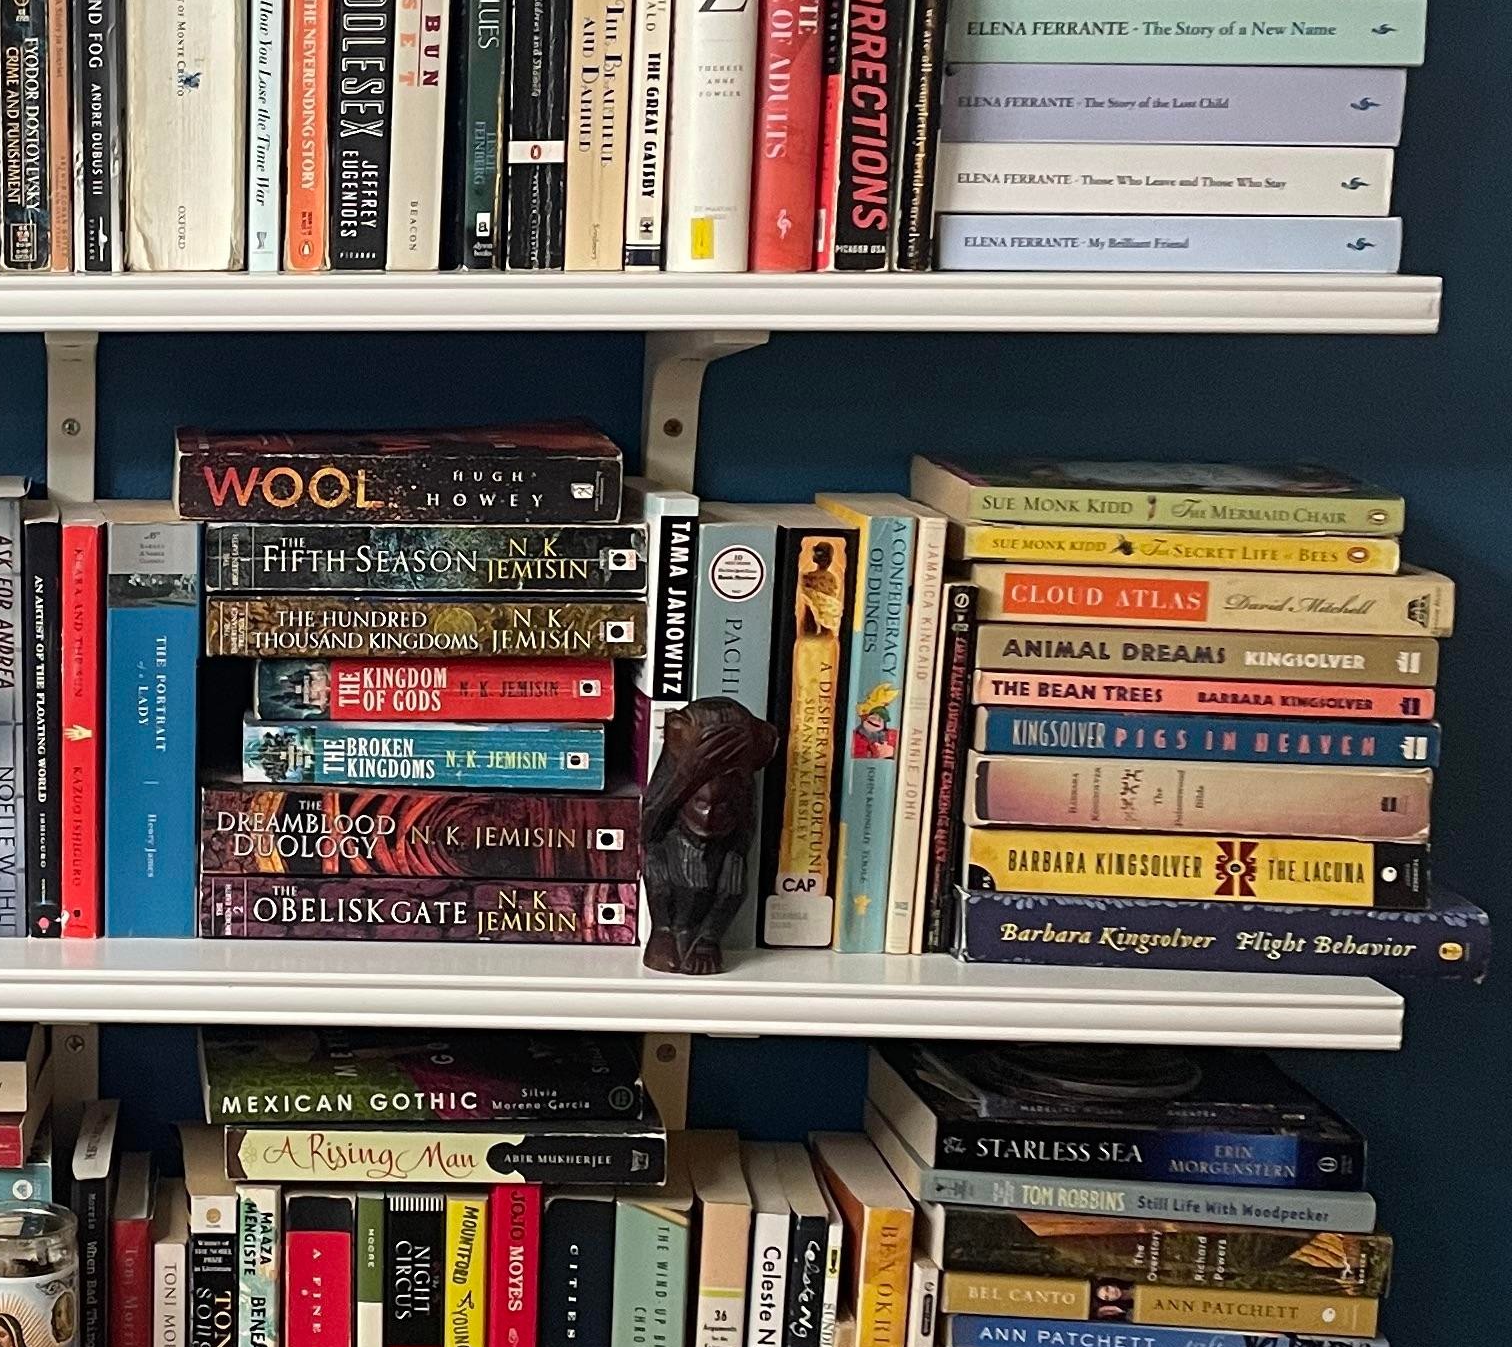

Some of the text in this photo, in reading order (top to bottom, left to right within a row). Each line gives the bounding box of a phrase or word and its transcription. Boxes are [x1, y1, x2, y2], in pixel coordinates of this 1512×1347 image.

[967, 20, 1129, 36] ELENA FERRANTE
[340, 150, 382, 240] JEFFREY EUGENIDES
[203, 467, 387, 509] WOOL
[263, 545, 477, 574] FIFTH SEASON
[662, 521, 691, 695] TAMA JANOWITZ
[1010, 583, 1203, 612] CLOUD ATLAS
[1002, 638, 1226, 664] ANIMAL DREAMS
[782, 878, 817, 893] CAP
[1236, 931, 1417, 959] Flight Behavior
[221, 1091, 478, 1115] MEXICAN GOTHIC
[758, 1245, 783, 1323] Celeste
[978, 1324, 1031, 1344] ANN
